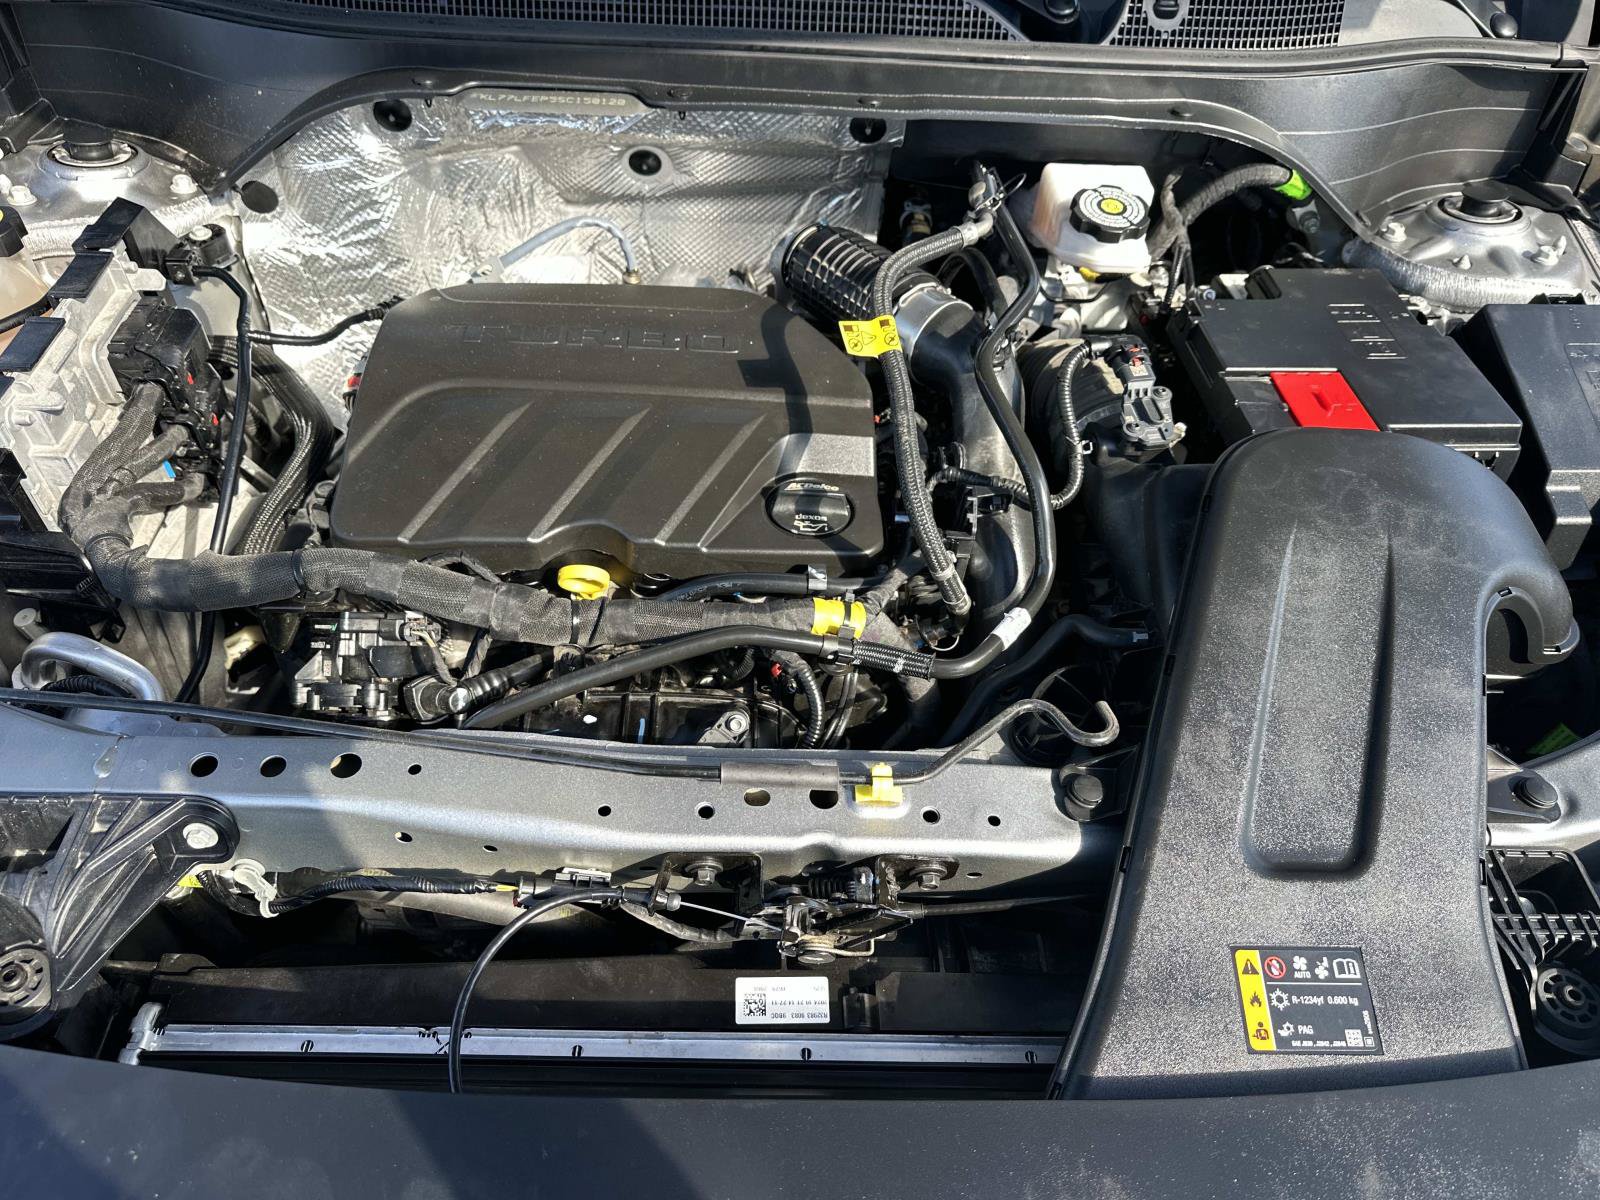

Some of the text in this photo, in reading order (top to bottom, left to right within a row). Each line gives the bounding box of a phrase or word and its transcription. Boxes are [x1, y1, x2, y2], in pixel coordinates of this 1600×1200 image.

[447, 324, 739, 353] TURBO
[795, 513, 828, 521] dexos
[1294, 971, 1311, 979] AUTO
[1292, 995, 1359, 1006] R-1234yf 0.600 kg
[1298, 1024, 1314, 1035] PAG
